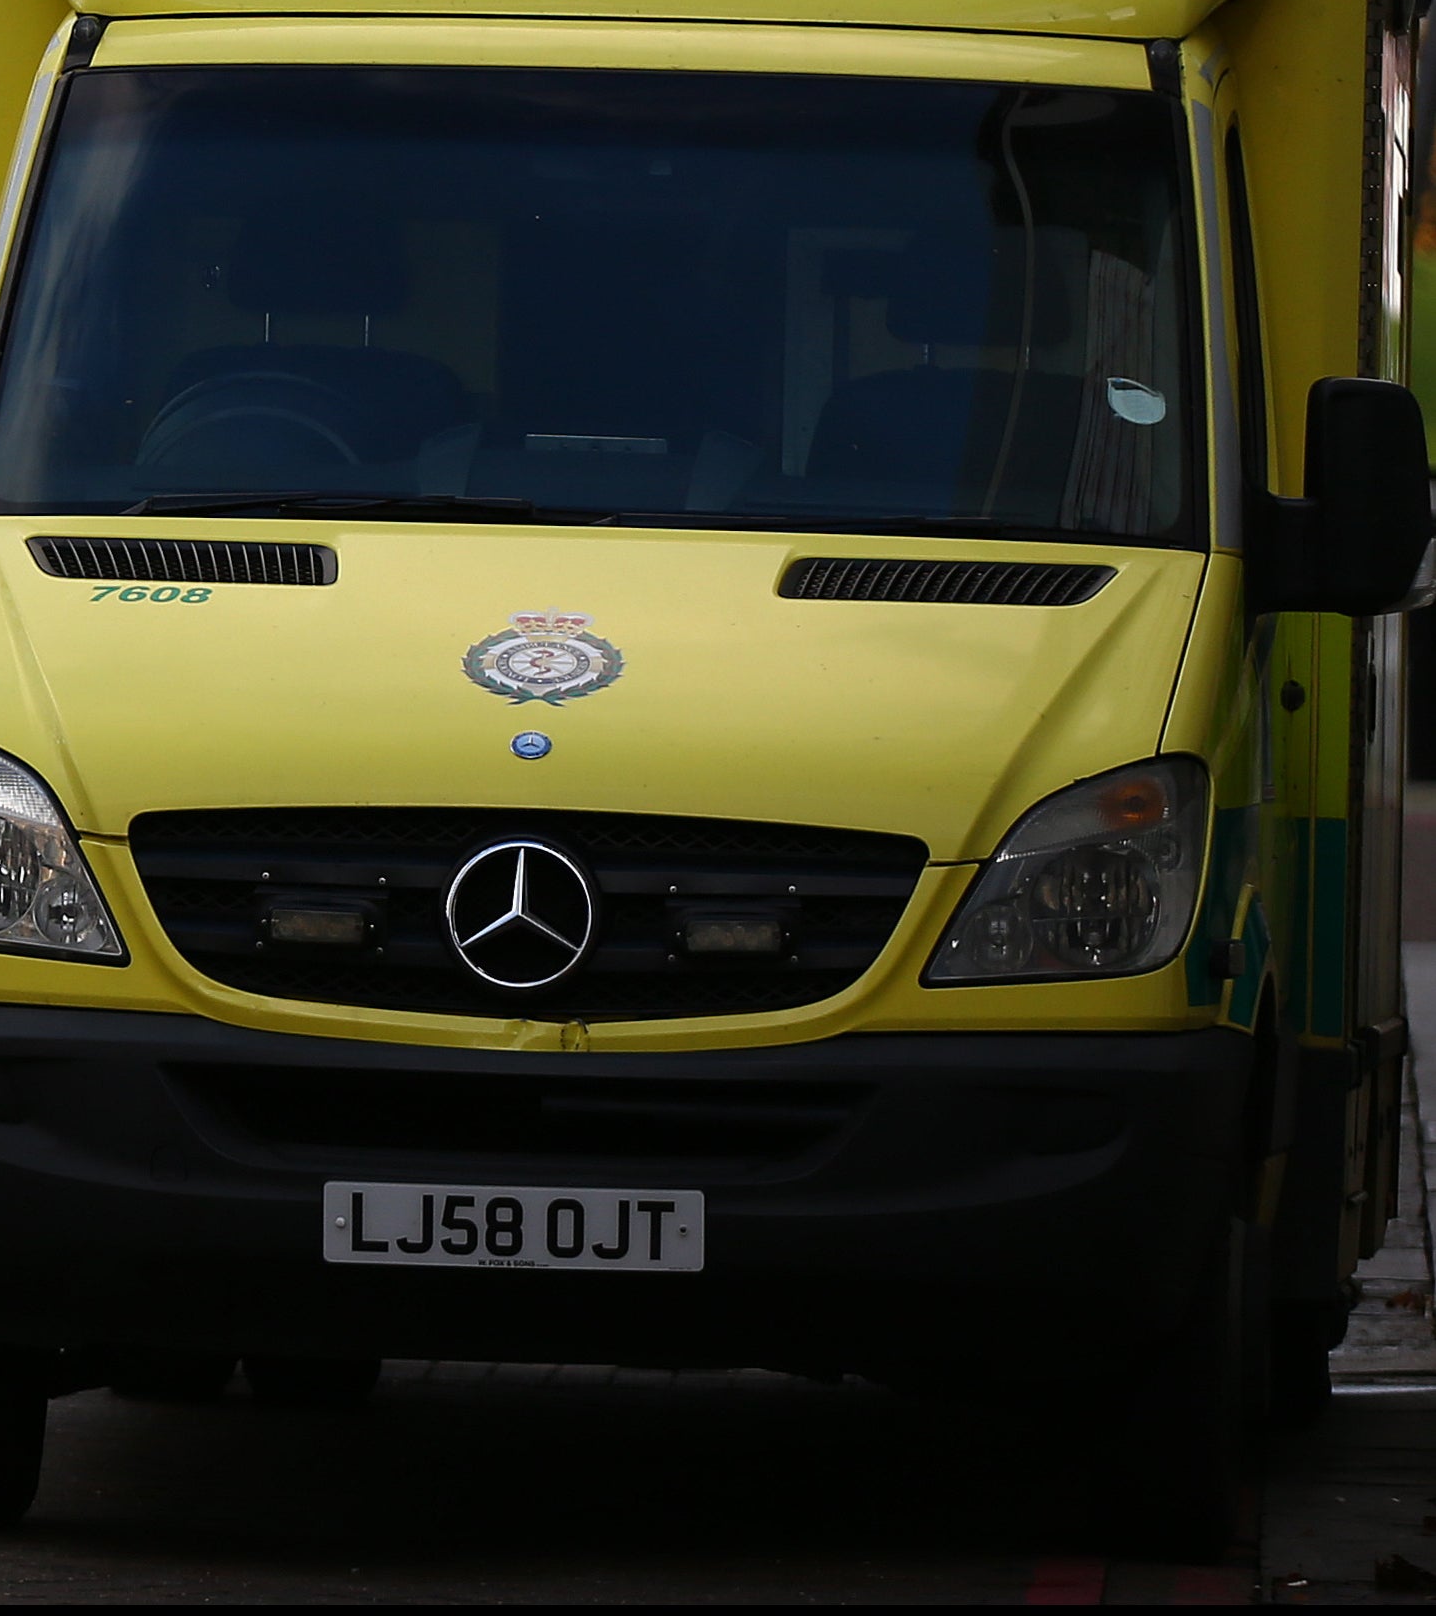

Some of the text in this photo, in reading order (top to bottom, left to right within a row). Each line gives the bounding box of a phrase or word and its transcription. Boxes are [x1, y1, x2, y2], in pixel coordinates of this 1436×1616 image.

[90, 585, 214, 604] 7608
[351, 1192, 675, 1262] LJ58 OJT
